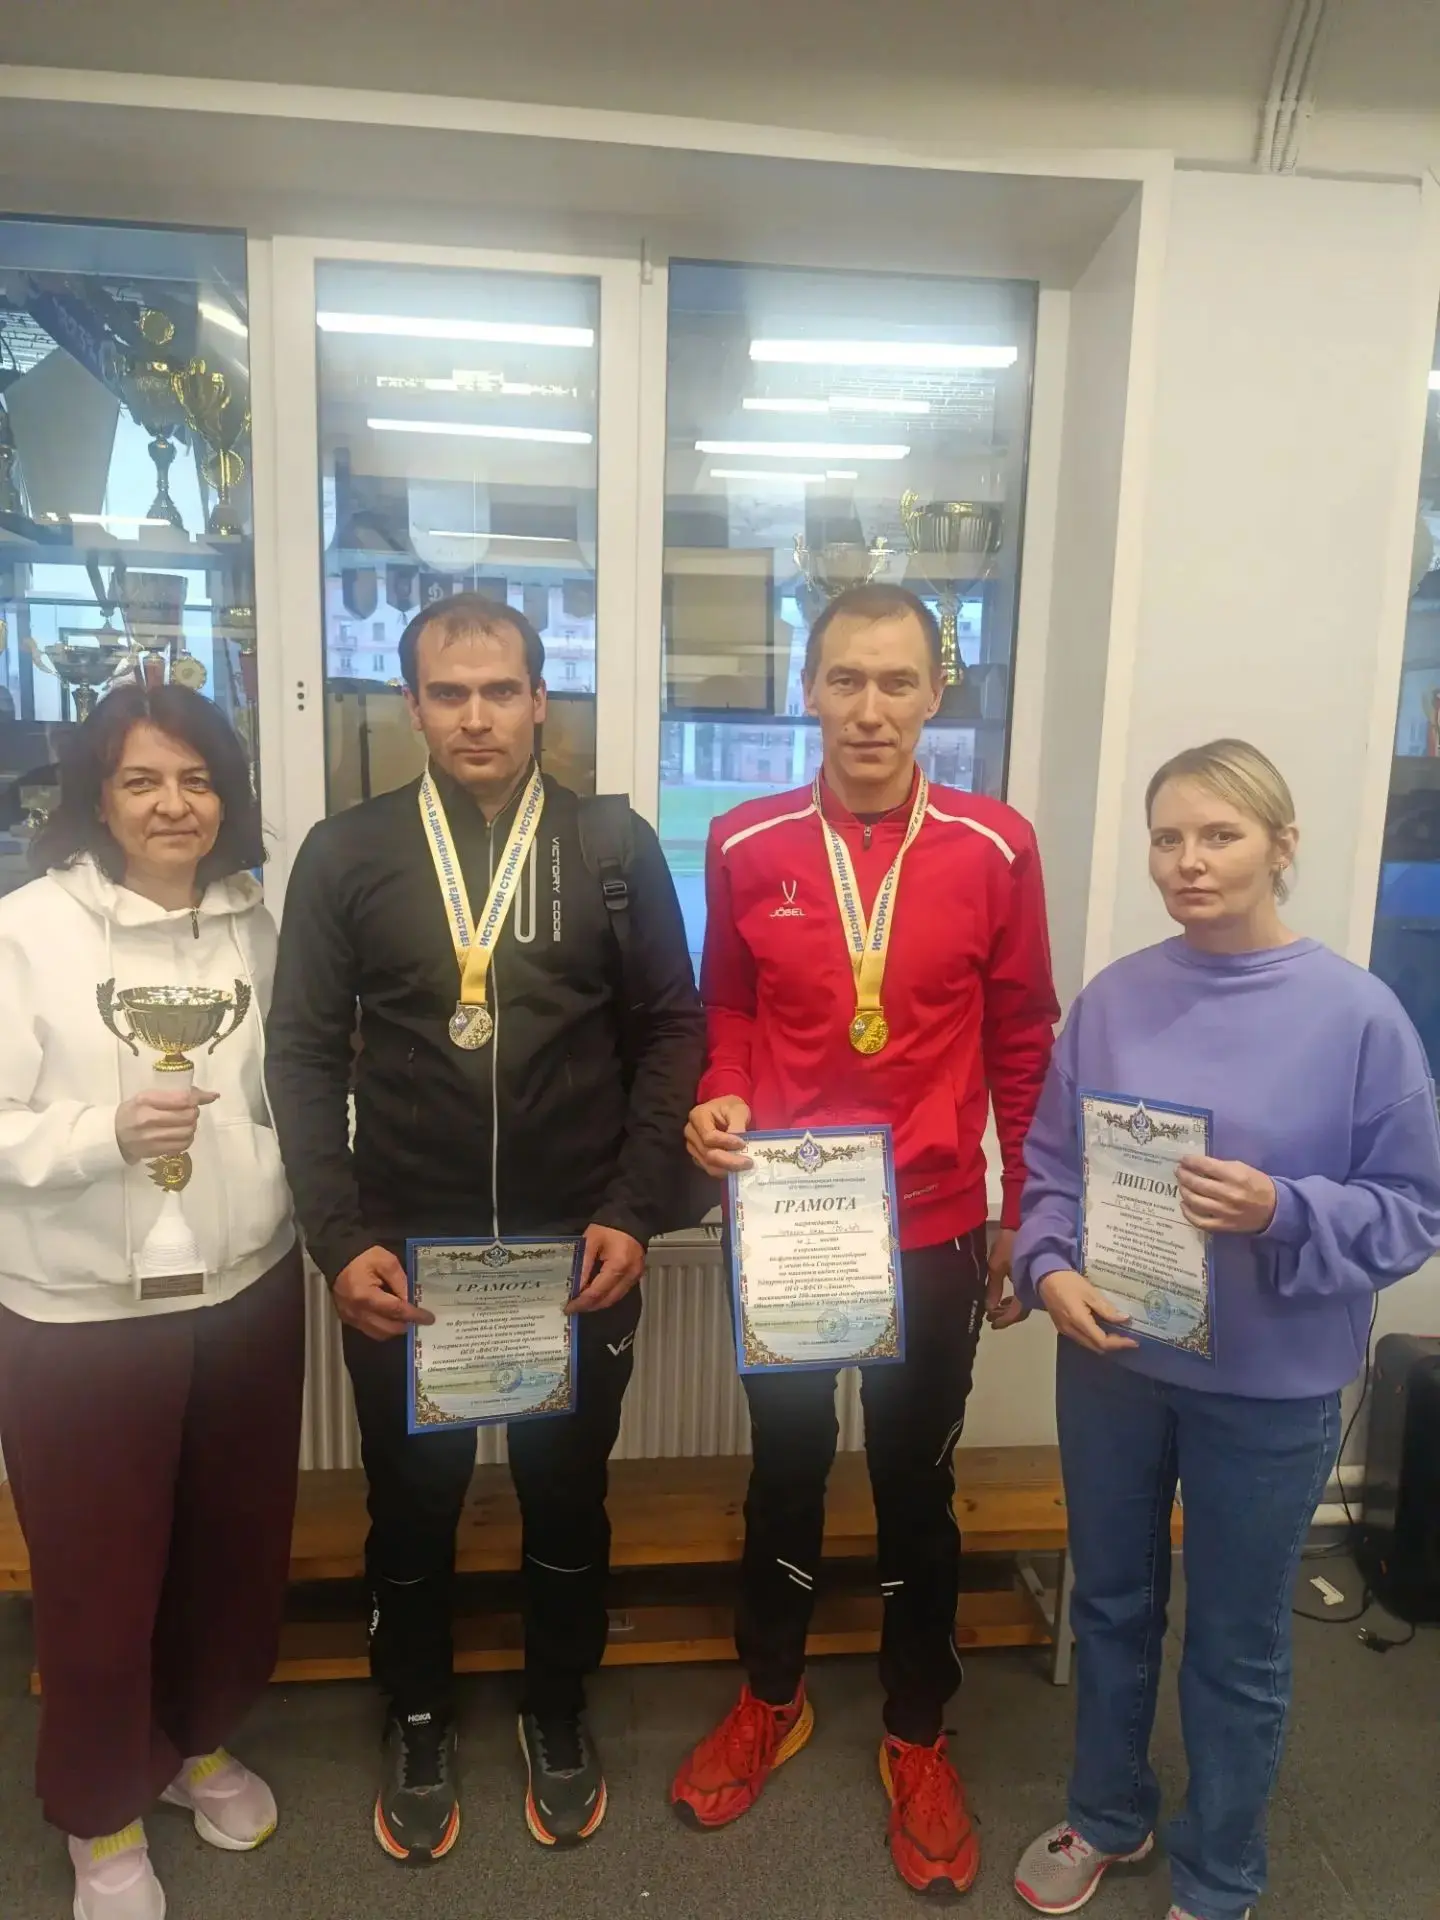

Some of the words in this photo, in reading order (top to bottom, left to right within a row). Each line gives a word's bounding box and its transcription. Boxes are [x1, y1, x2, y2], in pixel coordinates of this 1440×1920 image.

[422, 782, 433, 810] СИЛА
[428, 810, 437, 818] В
[430, 818, 454, 876] ДВИЖЕНИИ
[480, 891, 506, 947] ИСТОРИЯ
[500, 842, 522, 890] СТРАНЫ
[518, 785, 542, 836] ИСТОРИЯ
[552, 837, 560, 893] VICTORY
[447, 877, 456, 886] И
[842, 882, 851, 891] И
[553, 900, 561, 942] CODE
[872, 893, 889, 951] ИСТОРИЯ
[1112, 1171, 1178, 1198] ДИПЛОМ
[774, 1196, 857, 1214] ГРАМОТА
[456, 1281, 540, 1292] ГРАМОТА
[408, 1713, 431, 1722] HOKA
